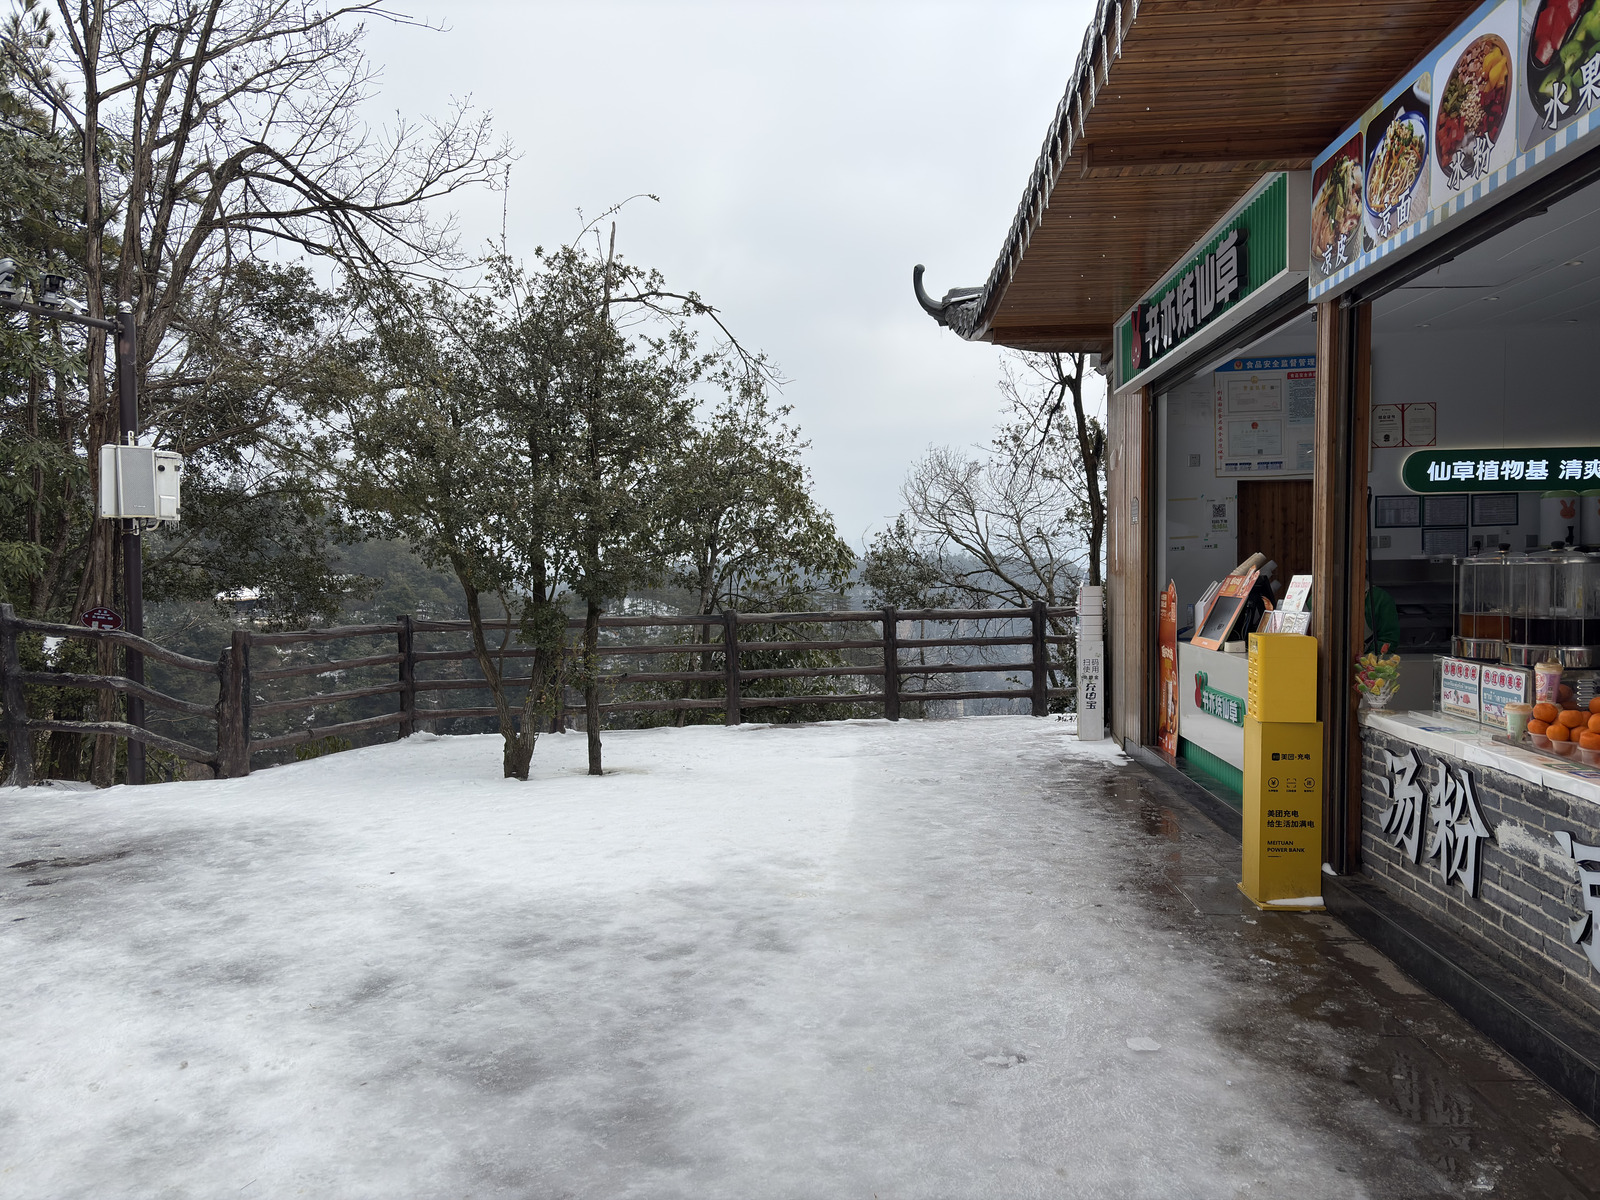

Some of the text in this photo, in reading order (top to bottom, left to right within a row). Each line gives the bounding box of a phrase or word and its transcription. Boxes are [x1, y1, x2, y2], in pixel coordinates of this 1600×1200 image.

[1447, 132, 1495, 192] 冰粉
[1376, 188, 1412, 239] 凉面
[1320, 234, 1350, 276] 凉皮
[1144, 229, 1243, 360] 书亦烧仙草
[1427, 459, 1549, 482] 仙草植物基
[1266, 809, 1300, 818] 美团充电
[1266, 819, 1315, 829] 给生活加满电
[1379, 748, 1493, 898] 汤粉
